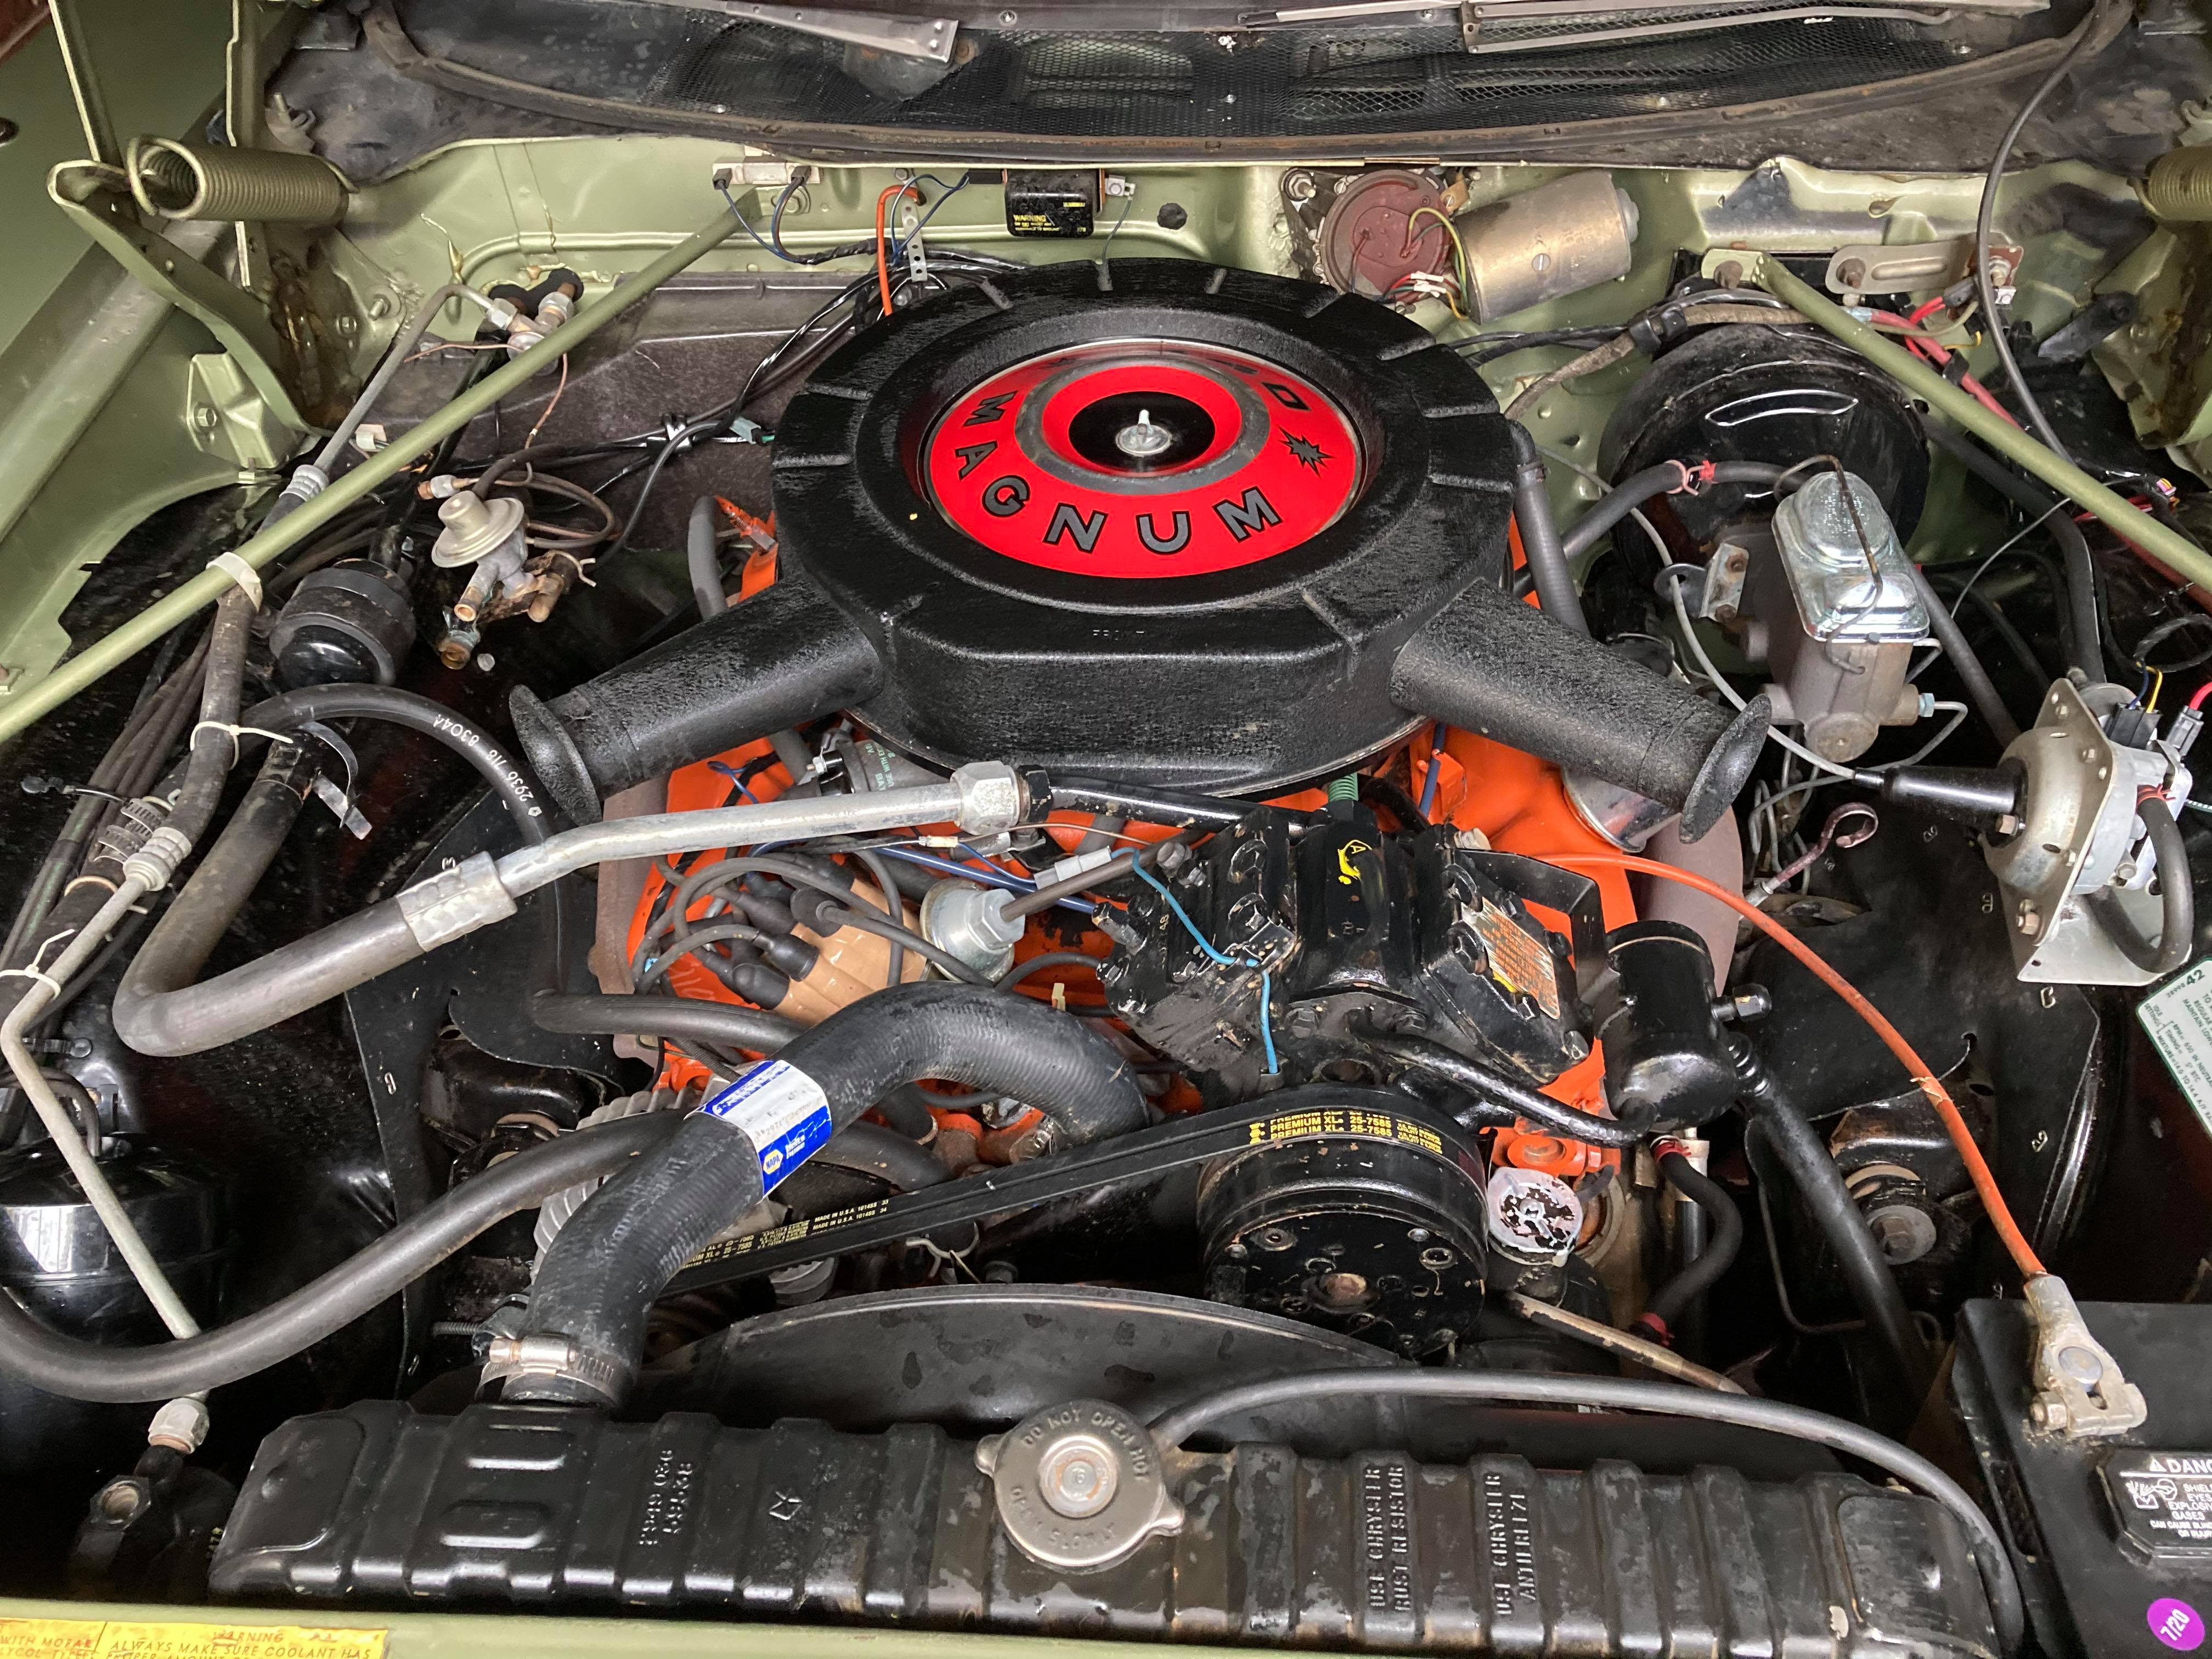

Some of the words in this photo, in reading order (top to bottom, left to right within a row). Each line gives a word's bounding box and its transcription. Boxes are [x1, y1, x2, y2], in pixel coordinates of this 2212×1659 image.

[953, 390, 1282, 555] MAGNUM
[483, 749, 506, 771] 718
[881, 757, 890, 772] WITH
[502, 771, 533, 805] 2936
[2187, 969, 2205, 985] 42
[2144, 1003, 2161, 1026] SETTINGS
[2153, 1005, 2163, 1017] IDLE
[2183, 999, 2203, 1027] MAINTAIN
[2193, 1000, 2212, 1025] REGULAR
[2184, 1042, 2194, 1053] 650
[2191, 1070, 2200, 1082] BTC
[2182, 1075, 2190, 1084] TO
[2197, 1099, 2207, 1109] A/F
[1270, 1116, 1321, 1133] PREMIUM
[1349, 1116, 1392, 1128] 25-7585
[1350, 1124, 1392, 1137] 25-7585
[765, 1153, 781, 1171] NAPA
[811, 1221, 830, 1231] MADE
[836, 1215, 854, 1224] U.S.A.
[813, 1214, 831, 1223] MADE
[838, 1207, 856, 1216] U.S.A.
[721, 1240, 754, 1254] 25-7585
[1021, 1425, 1044, 1446] DO
[1047, 1408, 1082, 1429] NOT
[1091, 1412, 1135, 1446] OPEN
[1129, 1448, 1150, 1482] HOT
[2149, 1520, 2166, 1529] CAN
[2172, 1511, 2205, 1521] GASES
[2159, 1608, 2191, 1641] 7/20
[110, 1641, 173, 1652] ALWAYS
[178, 1643, 218, 1655] MAKE
[224, 1645, 259, 1656] SURE
[264, 1646, 337, 1658] COOLANT
[341, 1649, 372, 1659] HAS
